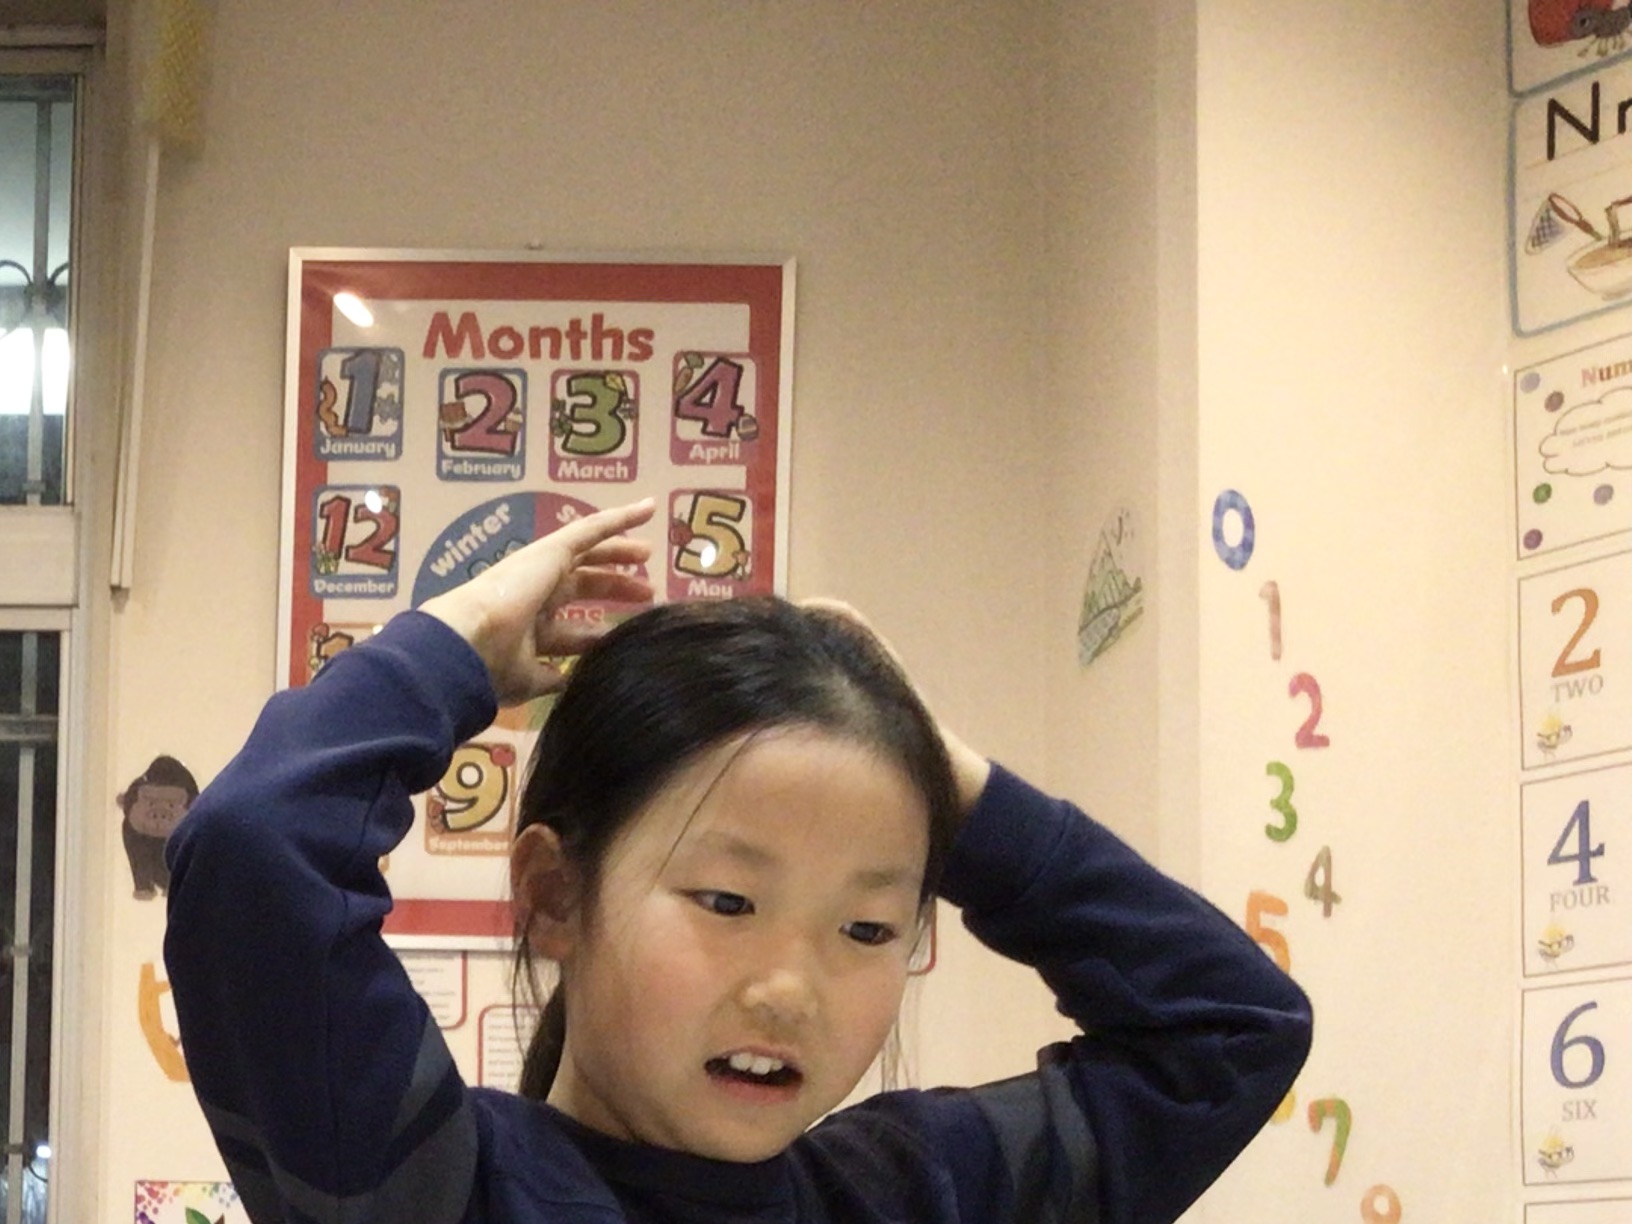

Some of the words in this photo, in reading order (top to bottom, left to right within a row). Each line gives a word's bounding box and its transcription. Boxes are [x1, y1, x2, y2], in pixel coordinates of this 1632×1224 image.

[421, 310, 655, 362] Months
[339, 350, 381, 436] 1
[452, 372, 520, 457] 2
[563, 373, 628, 456] 3
[674, 355, 745, 439] 4
[319, 438, 397, 459] January
[441, 458, 523, 480] February
[556, 460, 630, 480] March
[688, 440, 742, 462] April
[318, 493, 400, 573] 12
[429, 499, 513, 580] winter
[676, 491, 747, 580] 5
[1212, 489, 1255, 571] 0
[313, 578, 396, 596] December
[687, 579, 735, 600] May
[1258, 580, 1283, 661] 1
[1550, 586, 1603, 679] 2
[1288, 672, 1330, 749] 2
[1551, 674, 1605, 704] TWO
[434, 742, 509, 834] 9
[1264, 761, 1298, 843] 3
[1303, 845, 1342, 918] 4
[1546, 800, 1606, 887] 4
[1245, 889, 1292, 975] 5
[1549, 885, 1611, 913] FOUR
[1549, 1000, 1606, 1090] 6
[1307, 1096, 1353, 1187] 7
[1560, 1098, 1599, 1122] SIX
